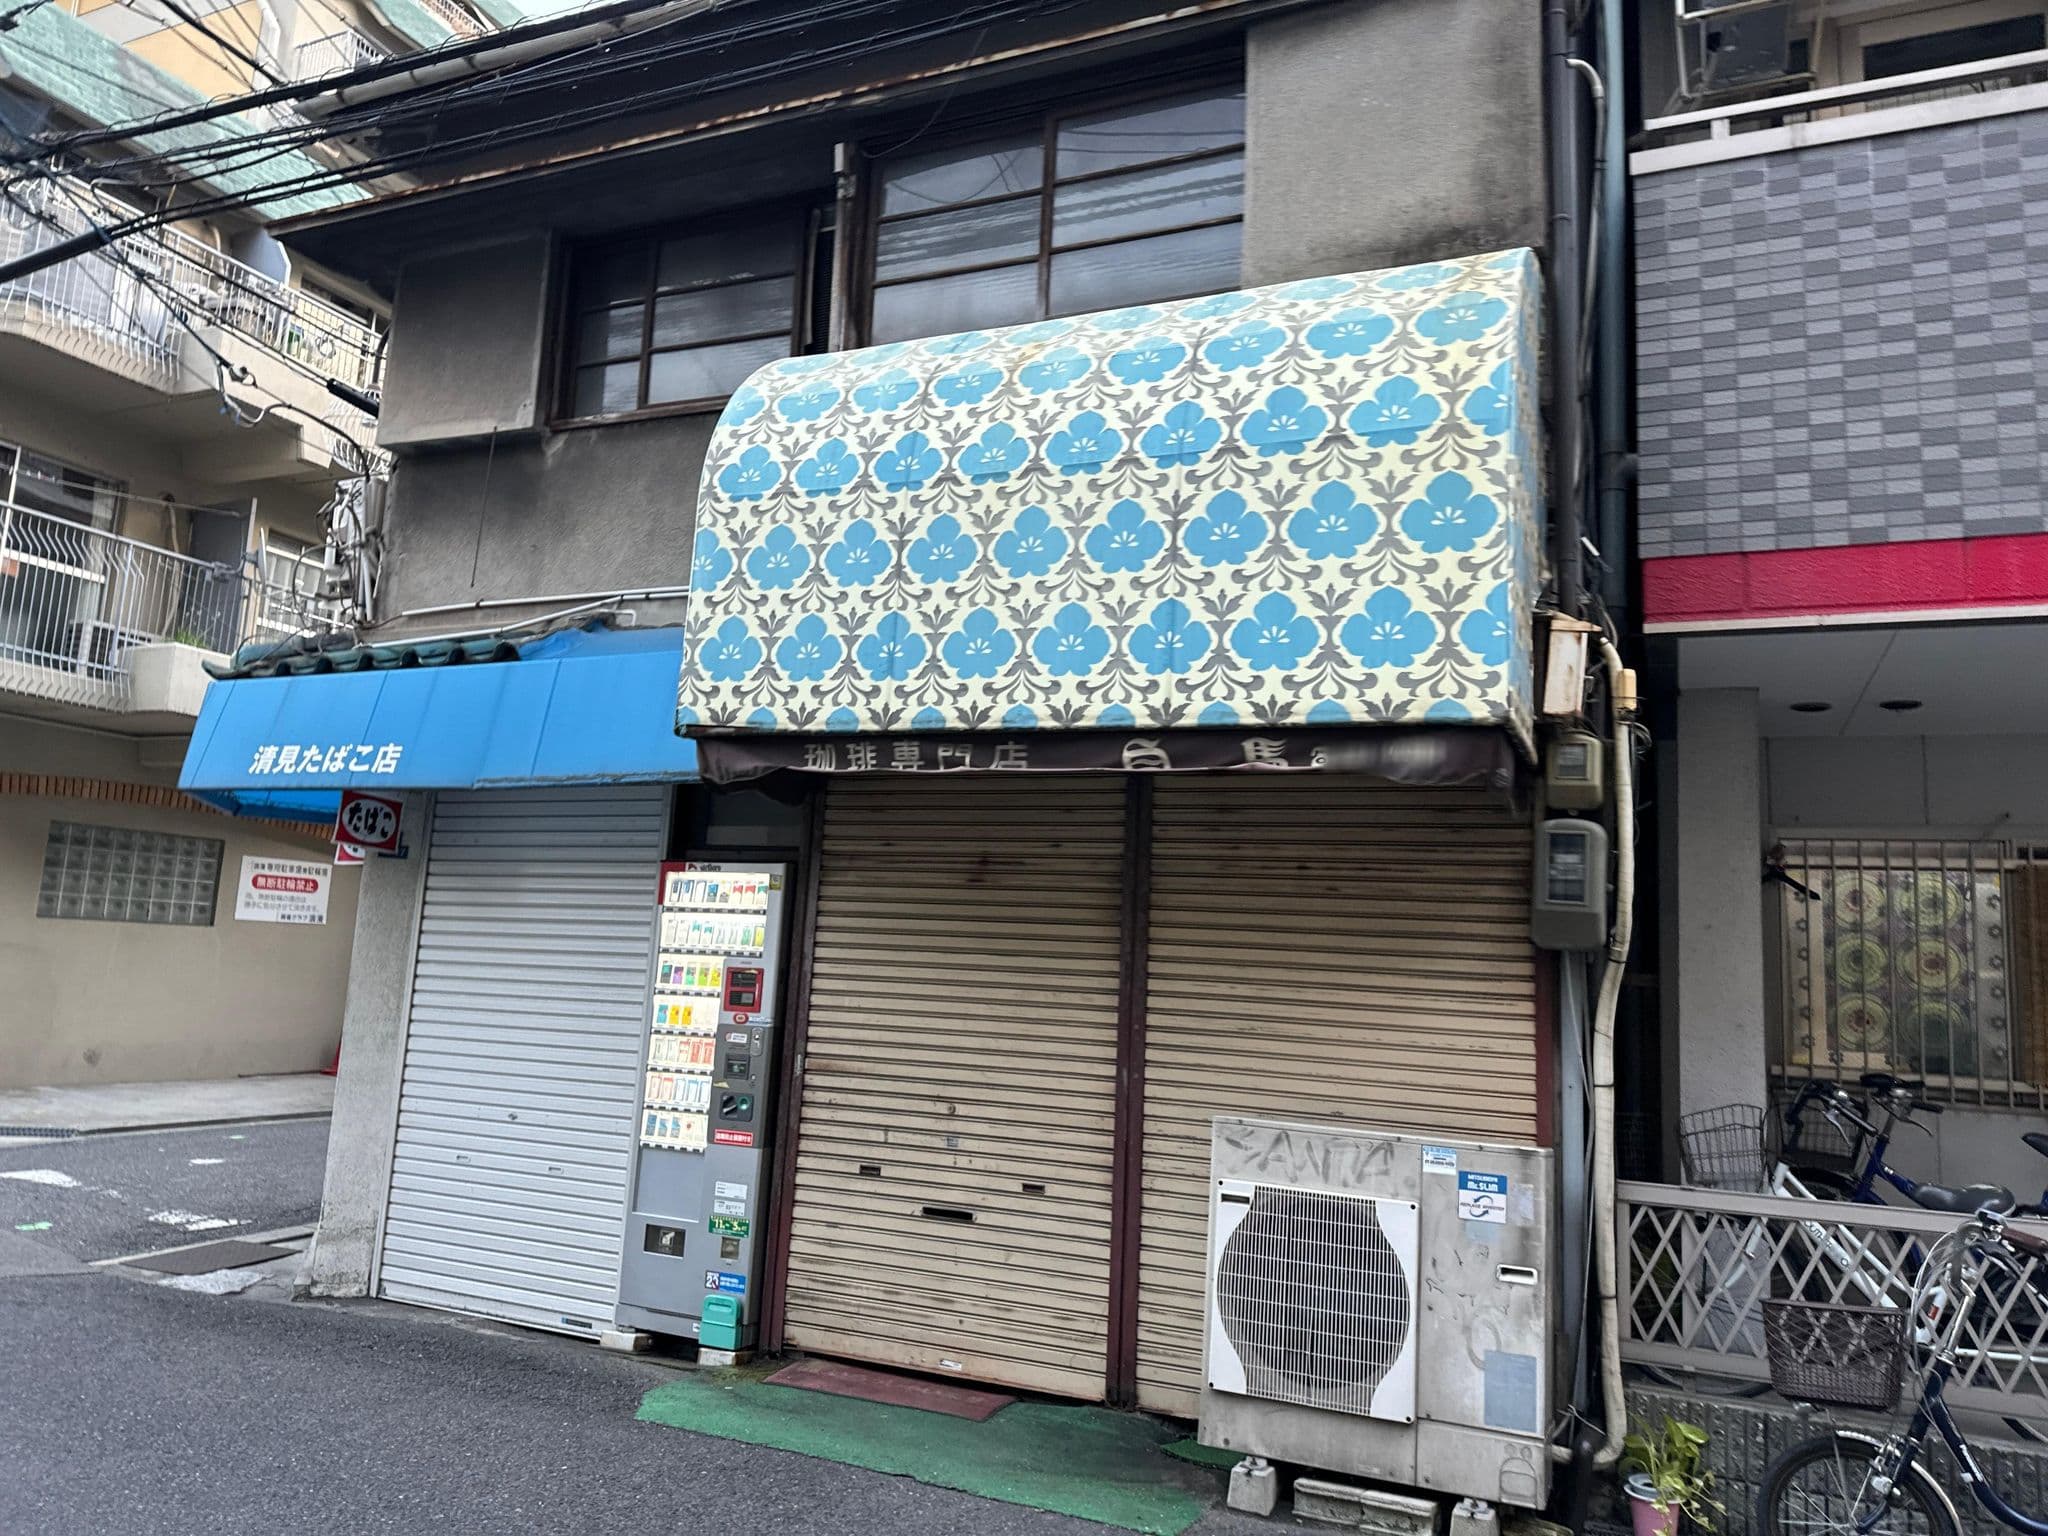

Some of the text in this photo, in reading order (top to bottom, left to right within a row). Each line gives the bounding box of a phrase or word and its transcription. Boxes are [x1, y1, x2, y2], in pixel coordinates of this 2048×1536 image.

[248, 743, 403, 774] 清見たばこ店
[348, 802, 393, 839] たばこ
